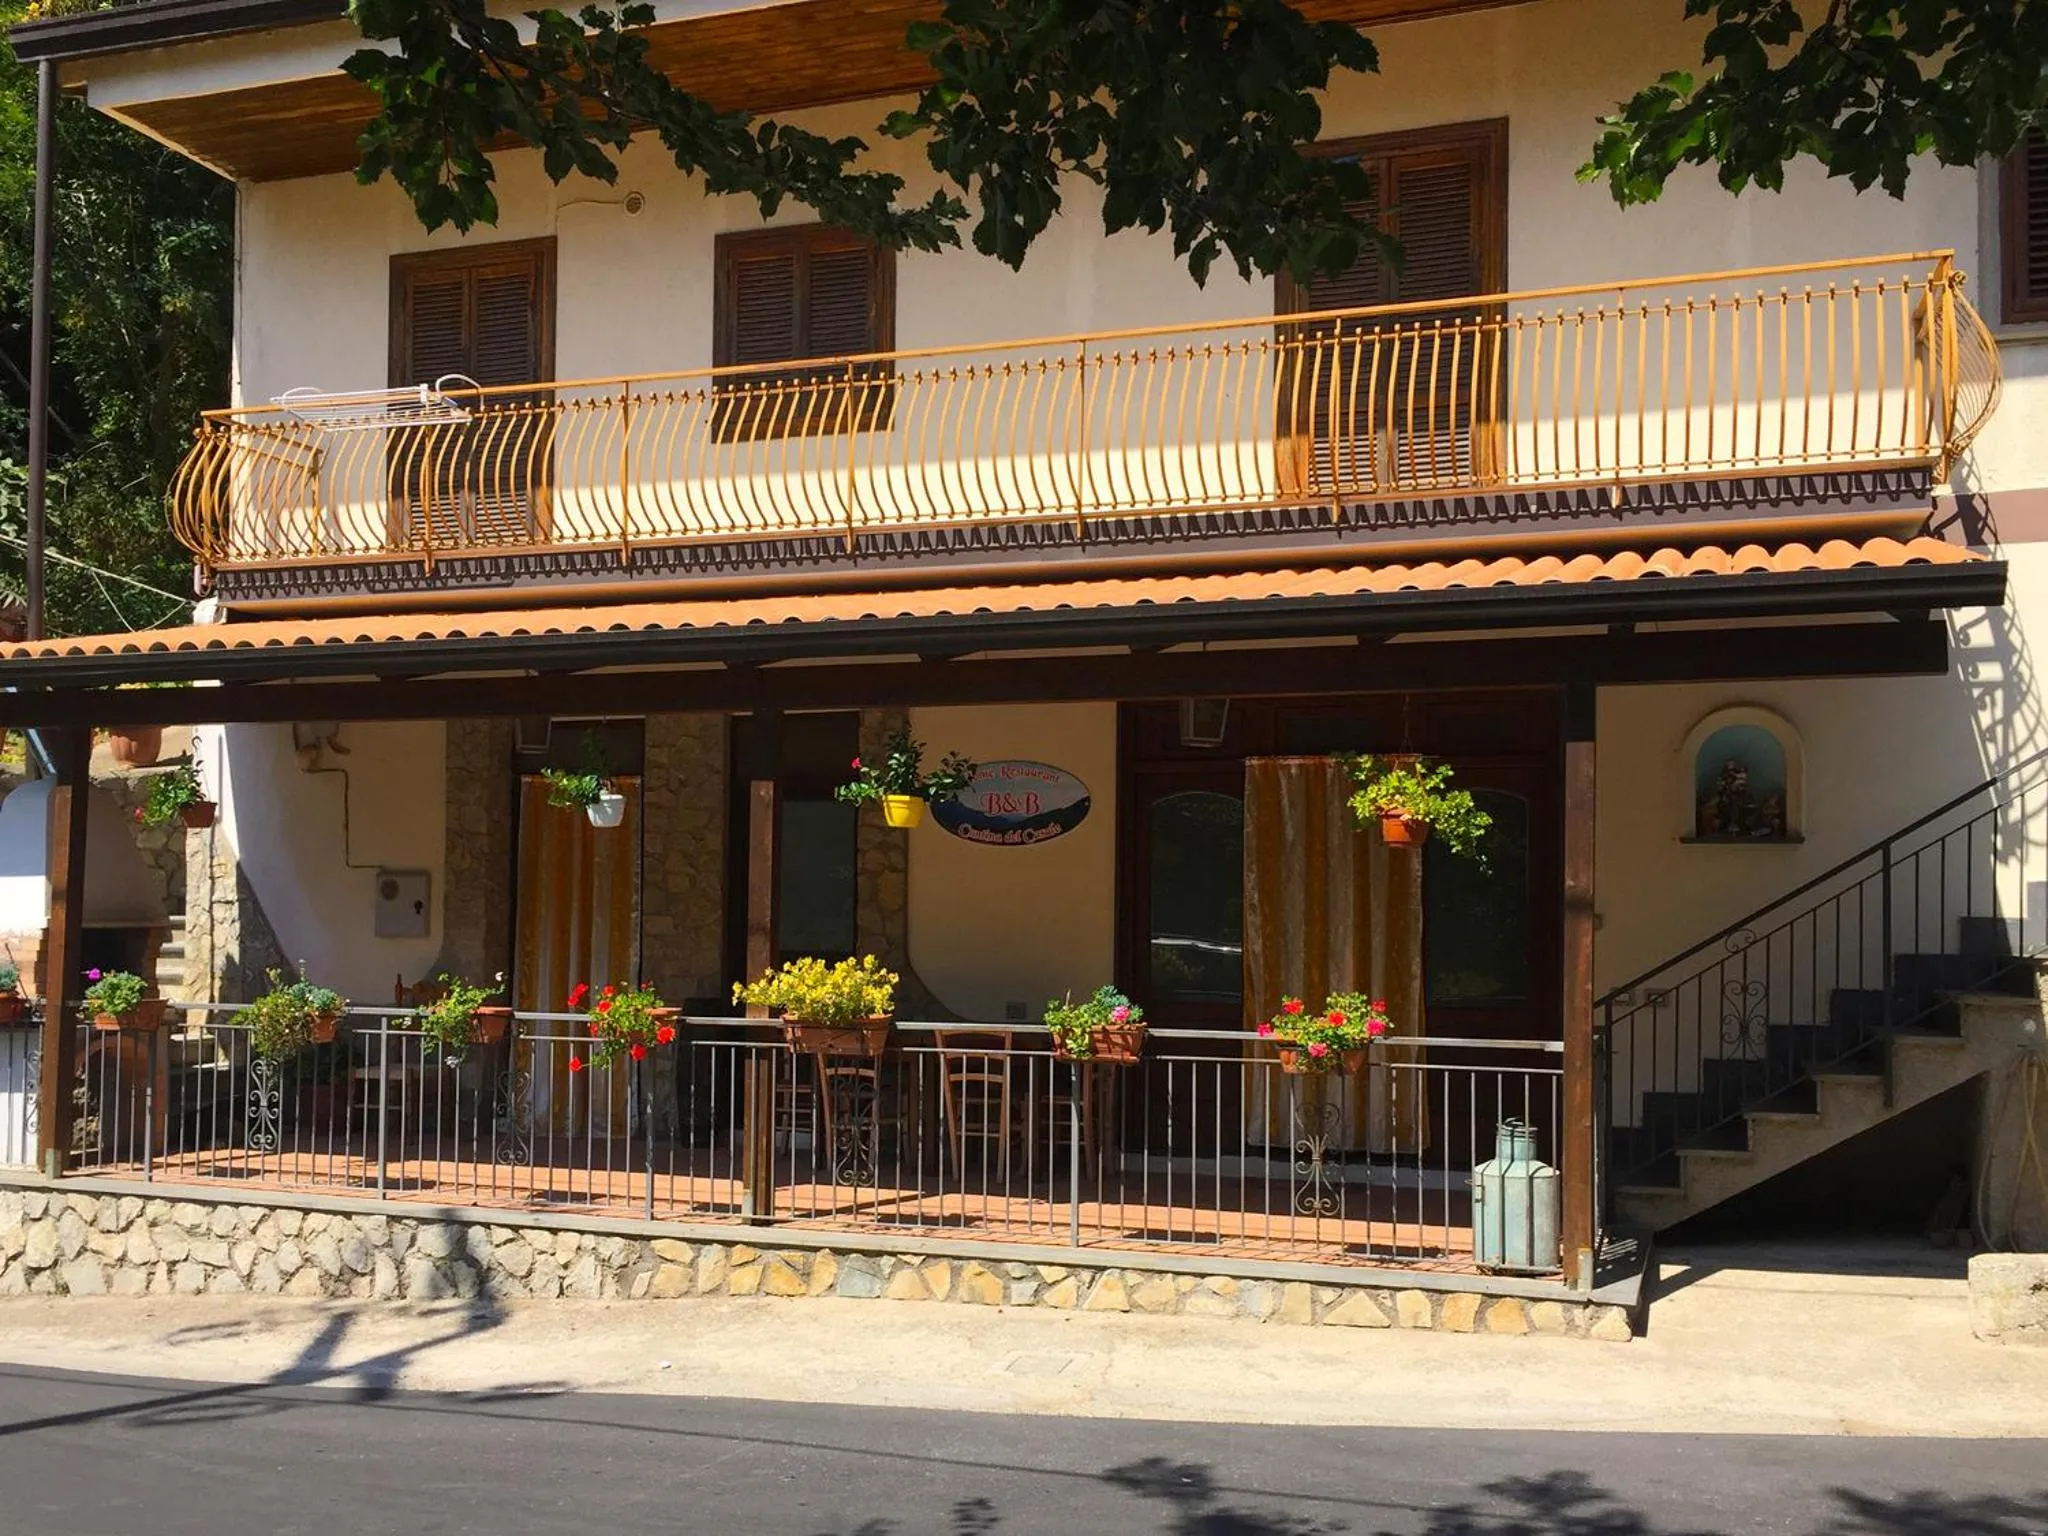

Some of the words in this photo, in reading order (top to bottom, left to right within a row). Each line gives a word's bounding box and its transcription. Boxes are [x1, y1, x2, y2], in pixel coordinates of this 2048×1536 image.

[969, 767, 994, 781] ome
[1000, 766, 1060, 784] Restaurant
[1004, 830, 1021, 843] del
